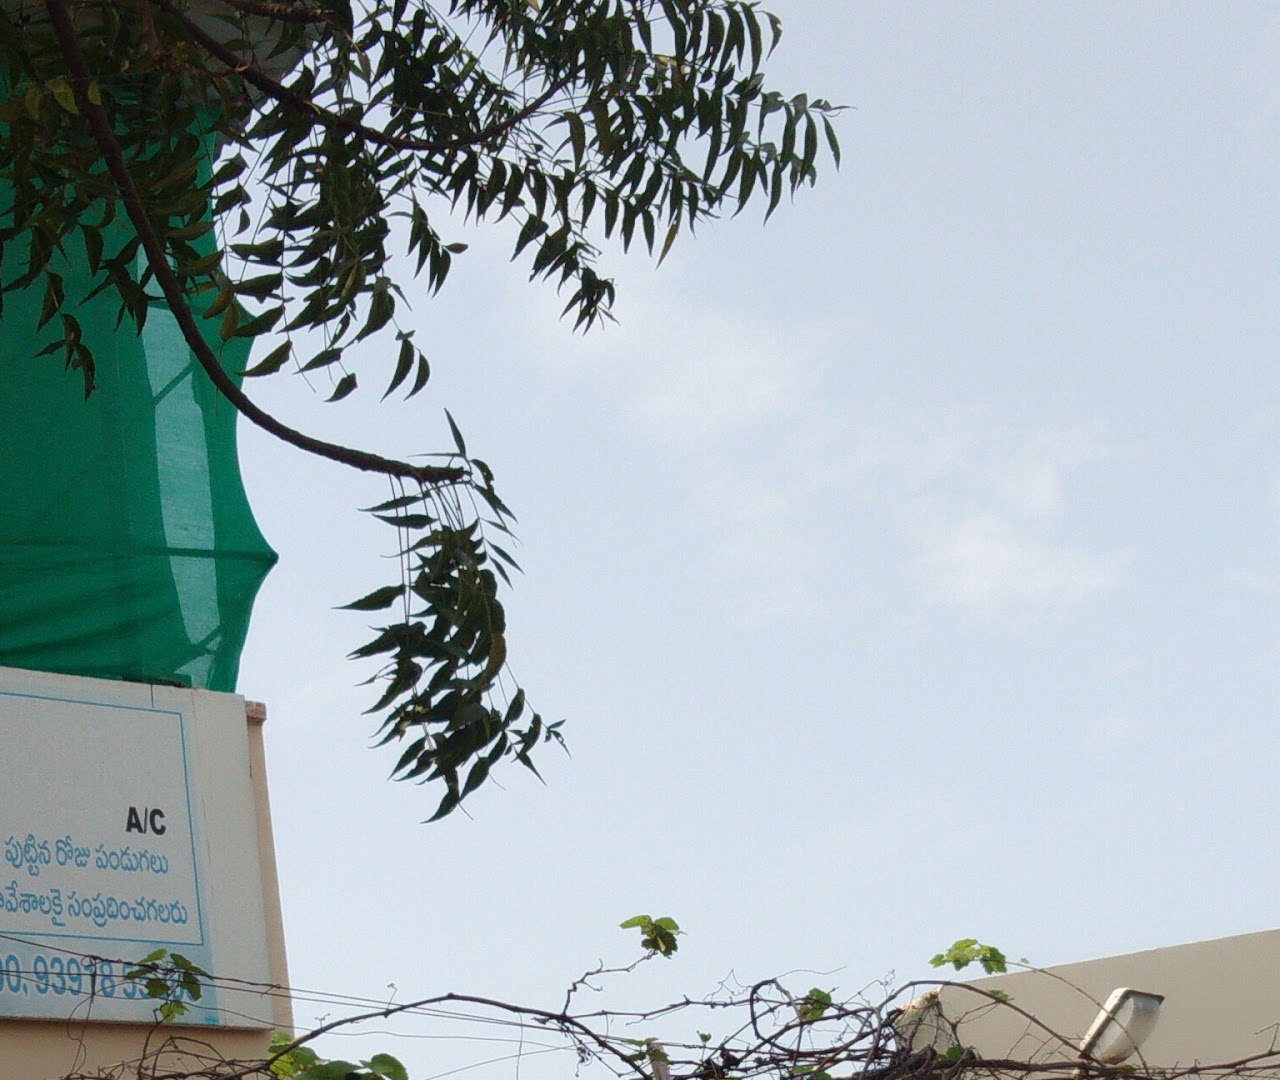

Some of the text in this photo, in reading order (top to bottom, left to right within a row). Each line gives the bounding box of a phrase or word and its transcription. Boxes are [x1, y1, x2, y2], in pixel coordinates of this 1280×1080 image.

[125, 806, 167, 836] A/C
[5, 833, 51, 877] పుట్టిన
[55, 835, 91, 868] రోజు
[95, 844, 170, 874] పండుగలు
[67, 890, 189, 928] సంప్రదించగలరు
